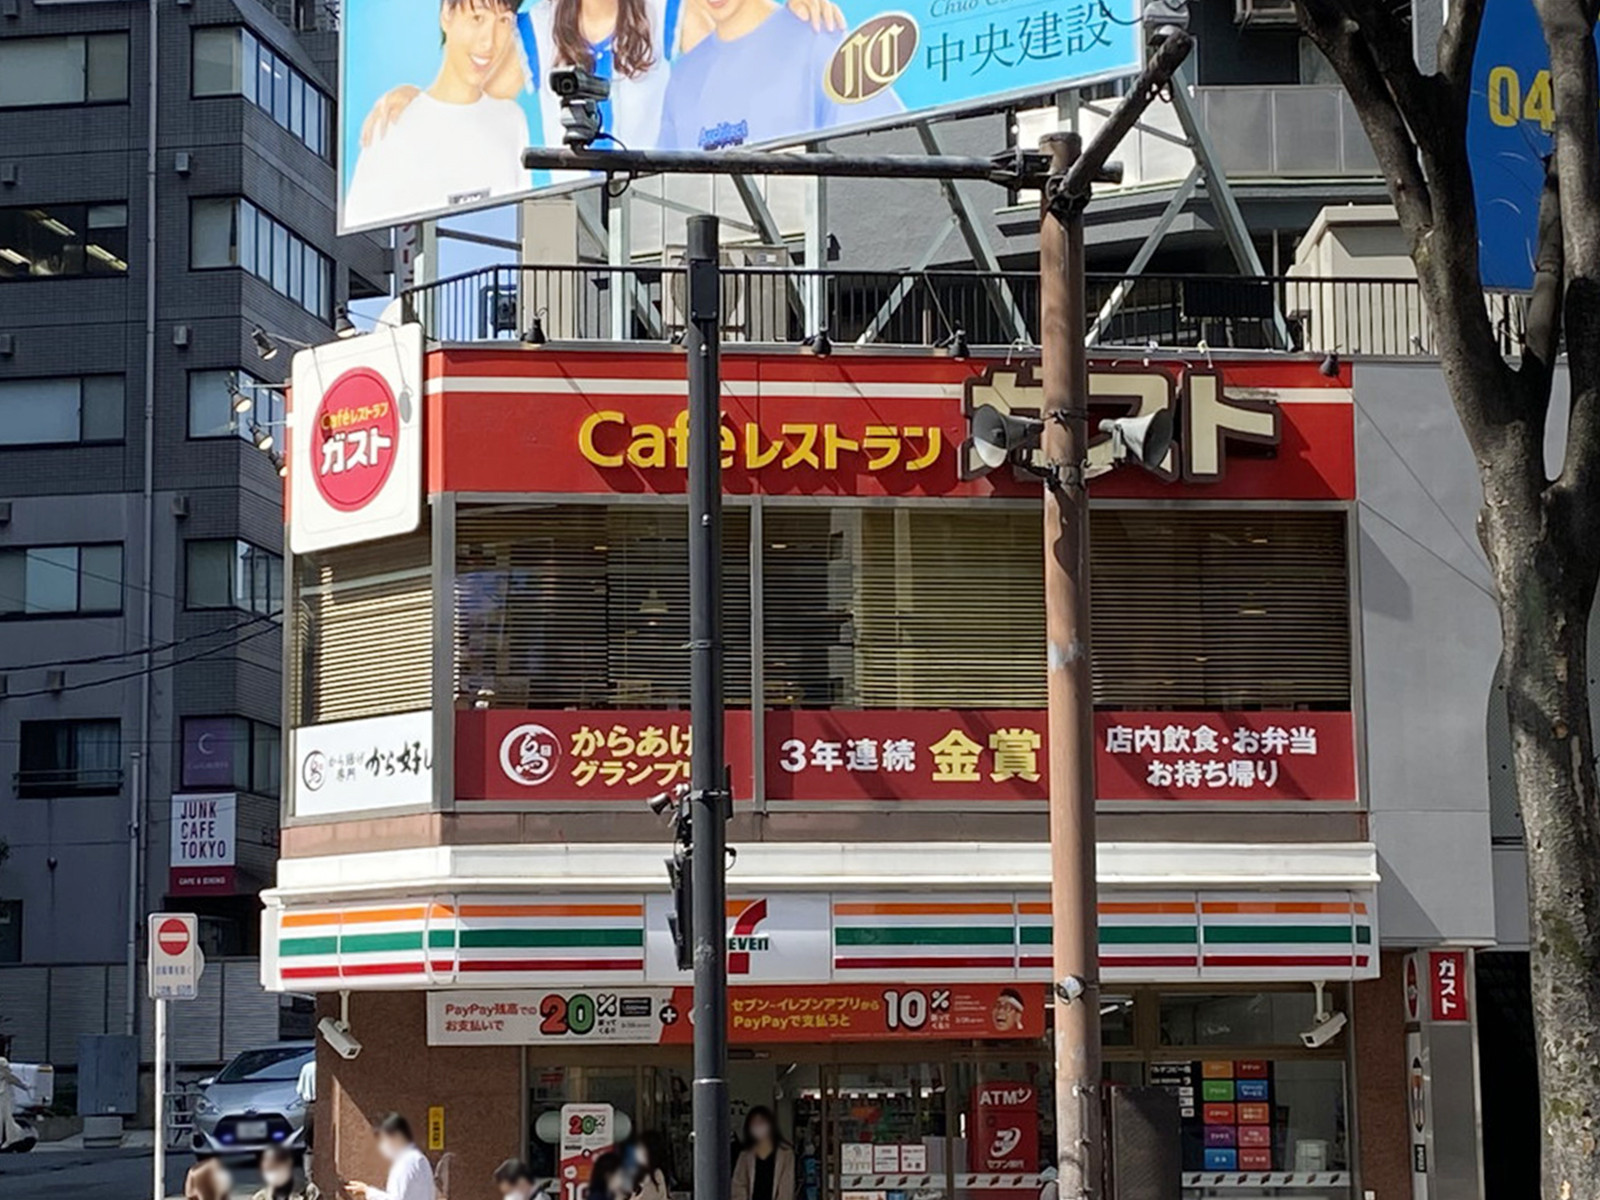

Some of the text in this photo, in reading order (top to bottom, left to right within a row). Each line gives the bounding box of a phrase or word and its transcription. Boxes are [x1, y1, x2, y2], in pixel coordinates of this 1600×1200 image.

[926, 2, 1112, 82] 中央建設
[321, 427, 392, 475] ガスト
[780, 728, 1041, 783] 3年連続 金賞
[1146, 759, 1278, 787] お持ち帰り
[181, 801, 217, 819] JUNK
[181, 821, 215, 838] CAFE
[180, 840, 226, 858] TOKYO
[1438, 958, 1457, 1015] ガスト
